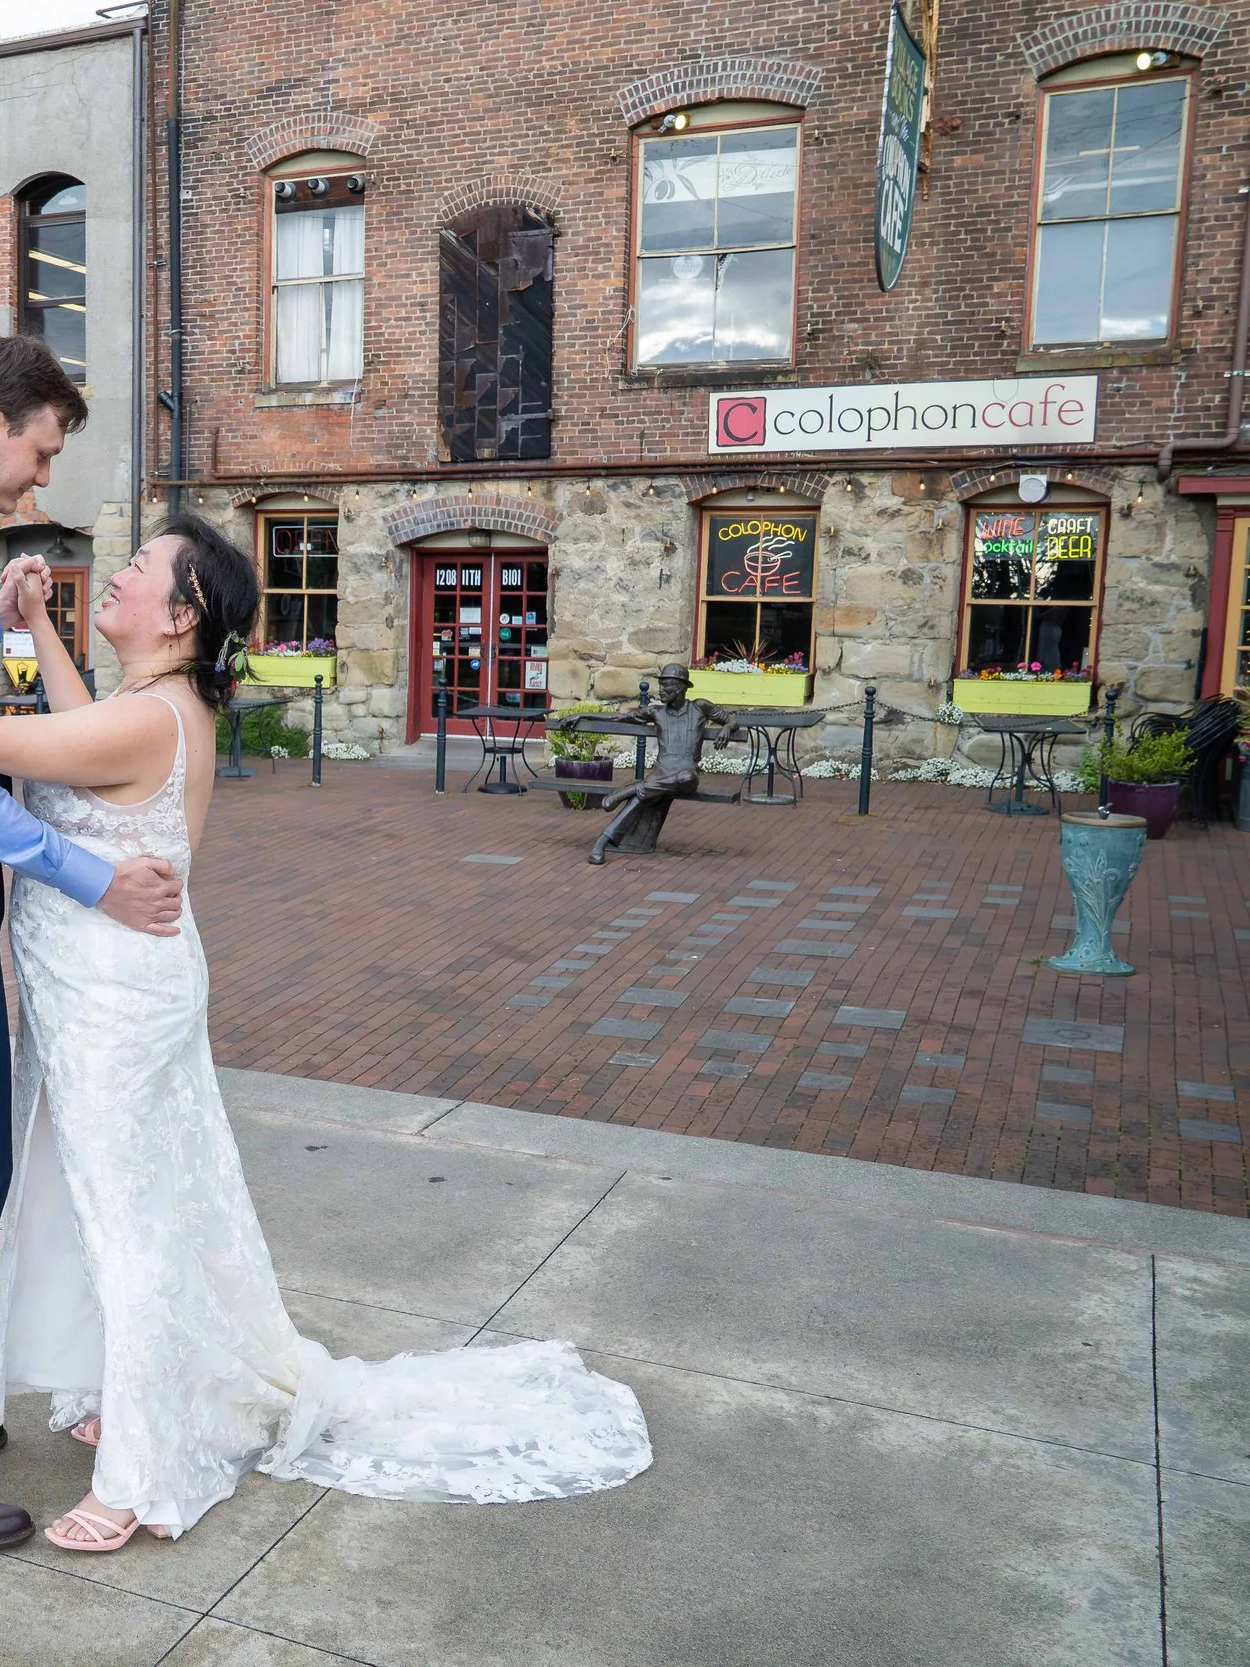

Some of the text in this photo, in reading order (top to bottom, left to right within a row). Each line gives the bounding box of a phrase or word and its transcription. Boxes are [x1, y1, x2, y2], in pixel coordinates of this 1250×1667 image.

[880, 178, 904, 254] CAFE
[718, 520, 808, 542] COLOPHON
[980, 517, 1025, 540] WINE
[1047, 516, 1093, 534] CRAFT
[1047, 535, 1092, 560] BEER
[436, 569, 521, 586] 1208 11TH B101
[721, 571, 801, 594] CAFE
